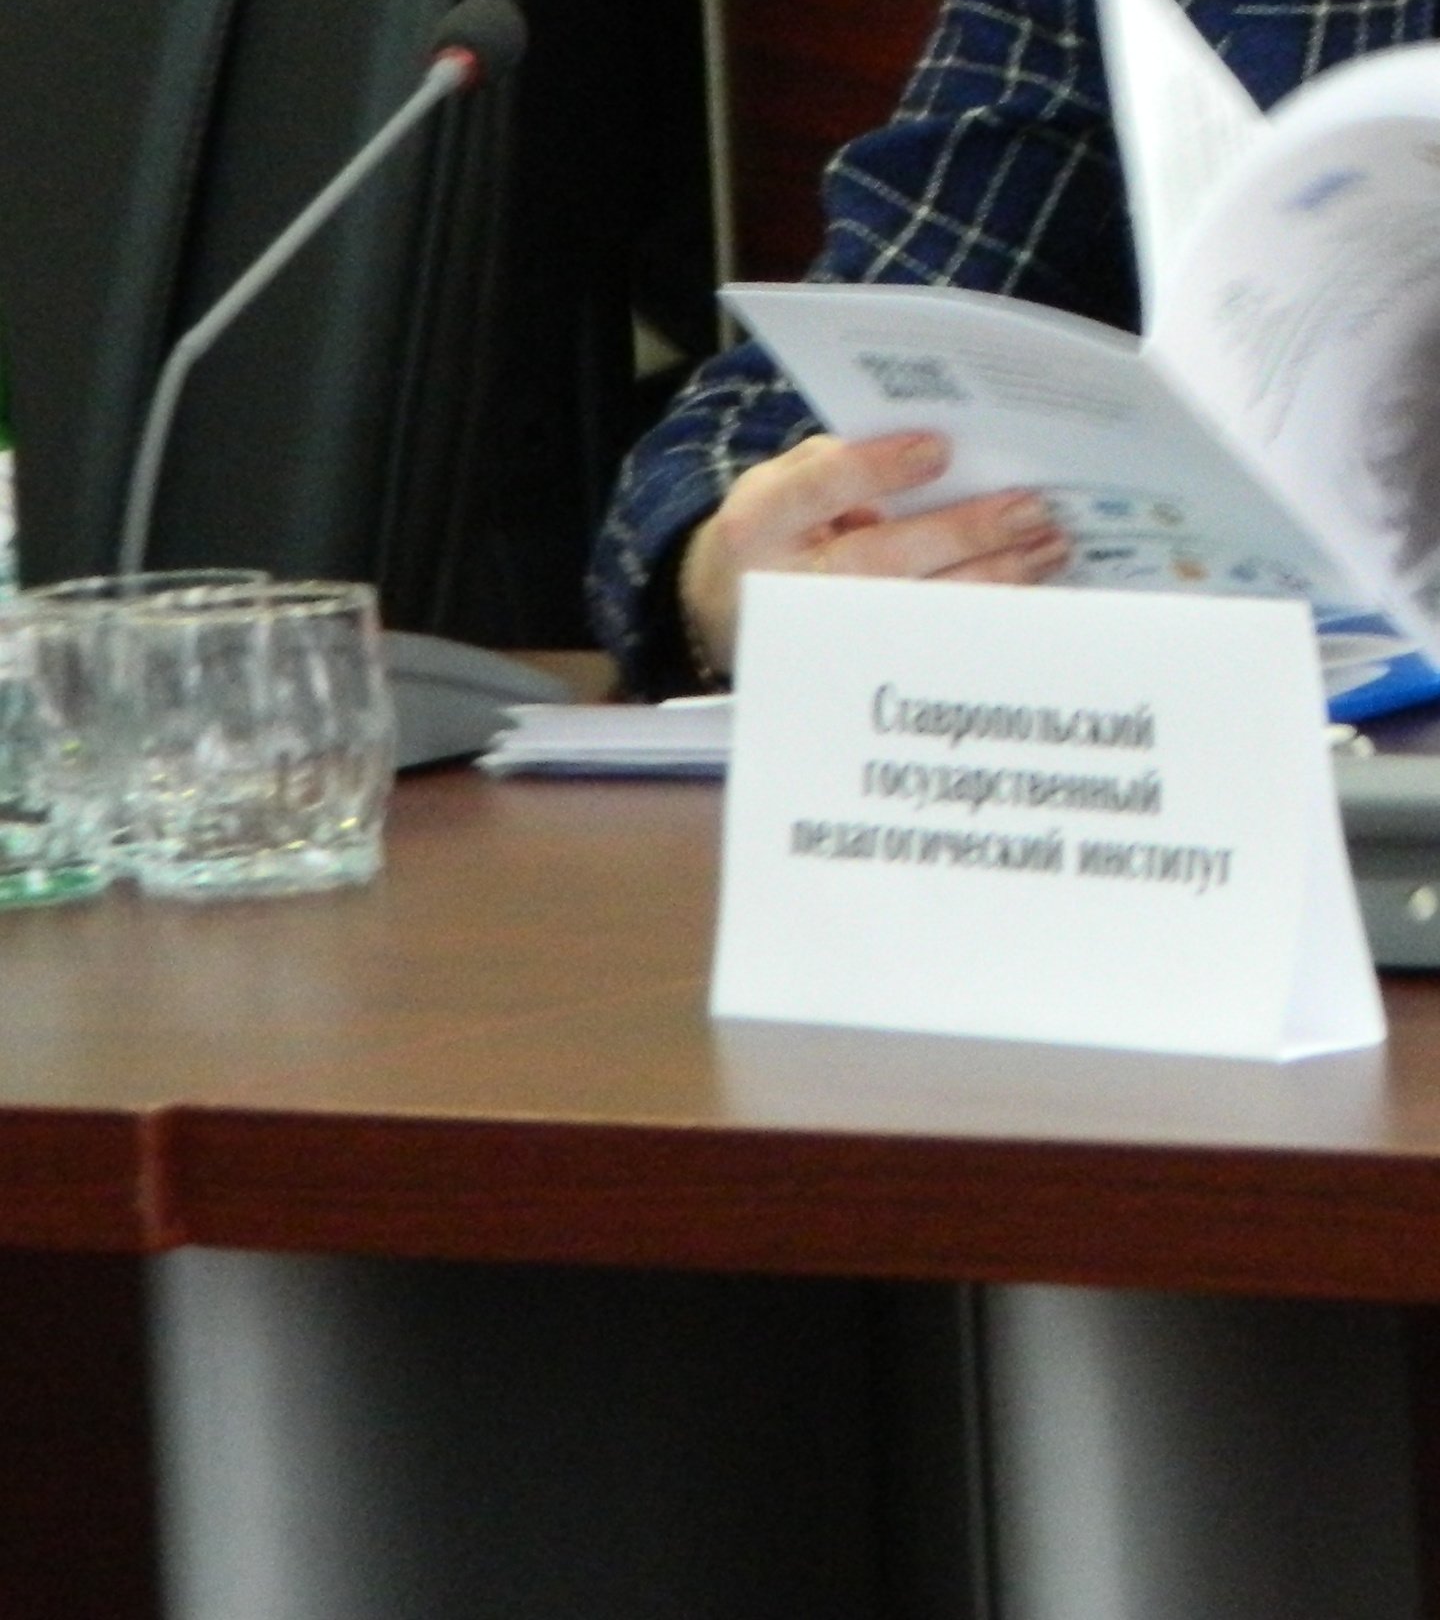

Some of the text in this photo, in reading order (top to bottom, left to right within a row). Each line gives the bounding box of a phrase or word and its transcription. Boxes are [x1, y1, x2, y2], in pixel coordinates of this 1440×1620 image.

[870, 681, 1155, 749] Ставропольский
[861, 759, 1162, 816] государственный
[789, 819, 1232, 894] педагогический институт
